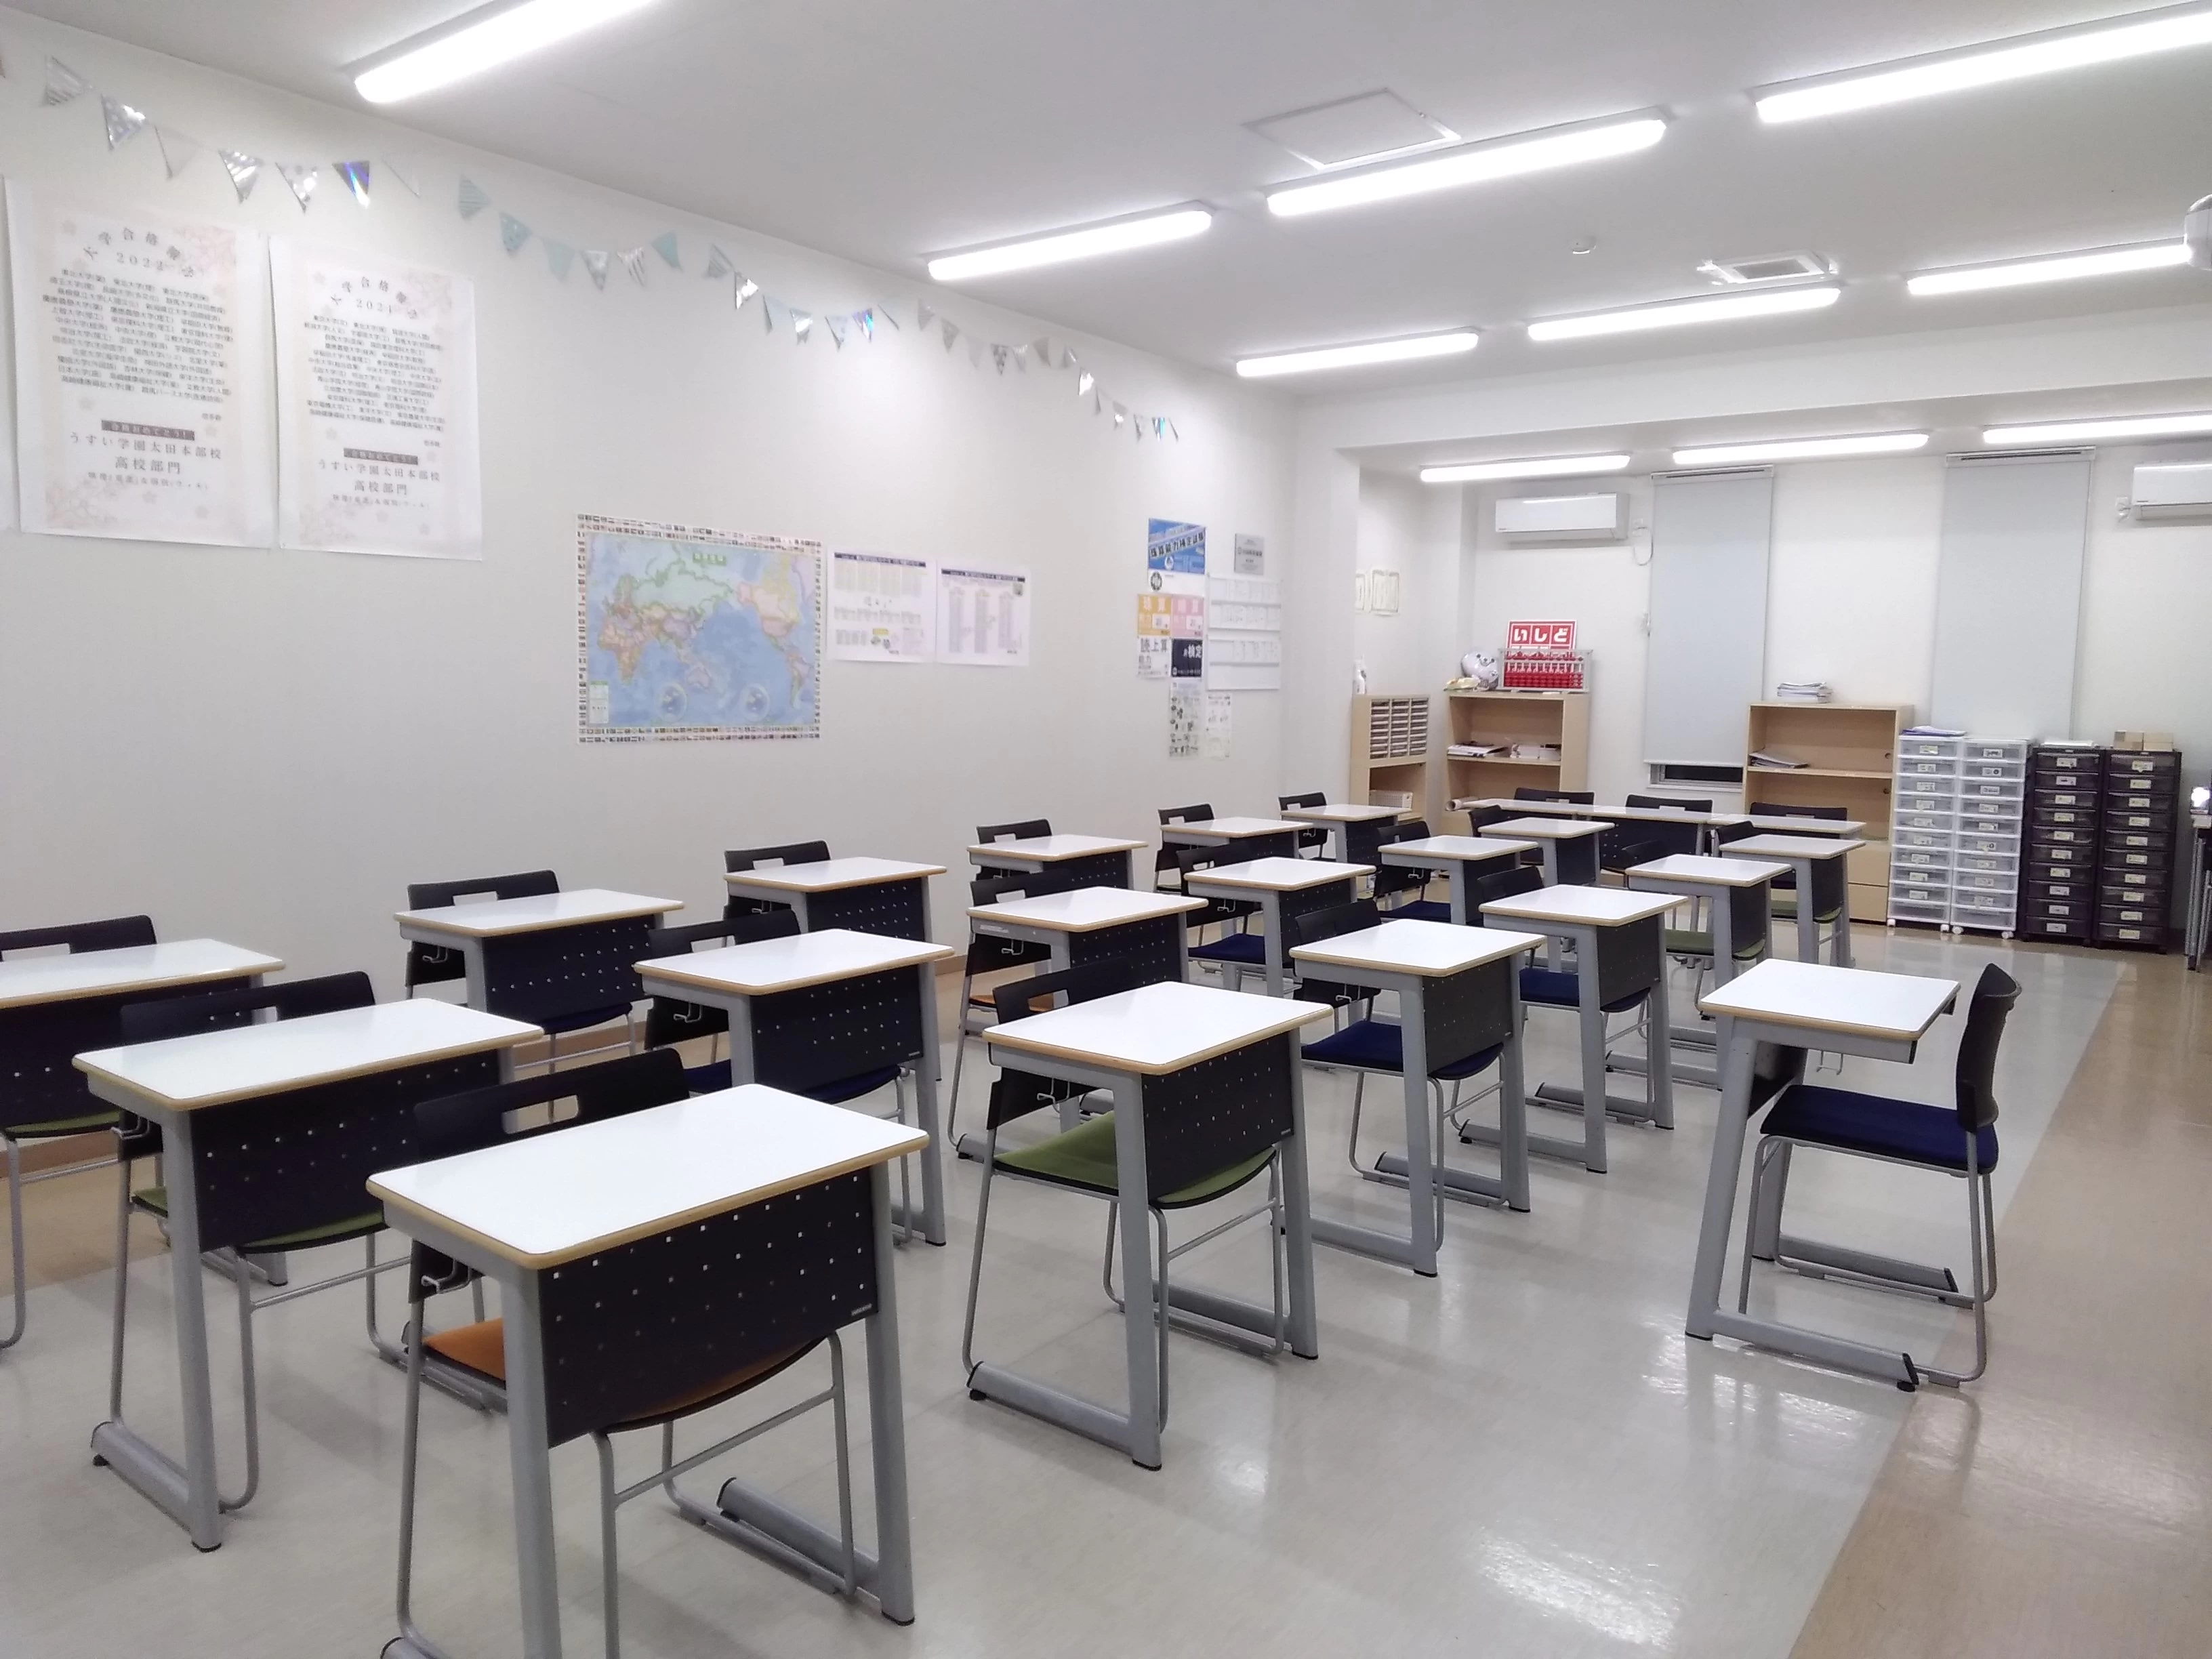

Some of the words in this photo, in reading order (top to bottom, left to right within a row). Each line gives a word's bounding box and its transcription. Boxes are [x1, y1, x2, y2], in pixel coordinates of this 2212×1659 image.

[70, 432, 222, 459] うすい学園太田本部校
[115, 456, 180, 474] 高校部門
[354, 479, 407, 495] 高校部門
[1514, 628, 1568, 642] いしど
